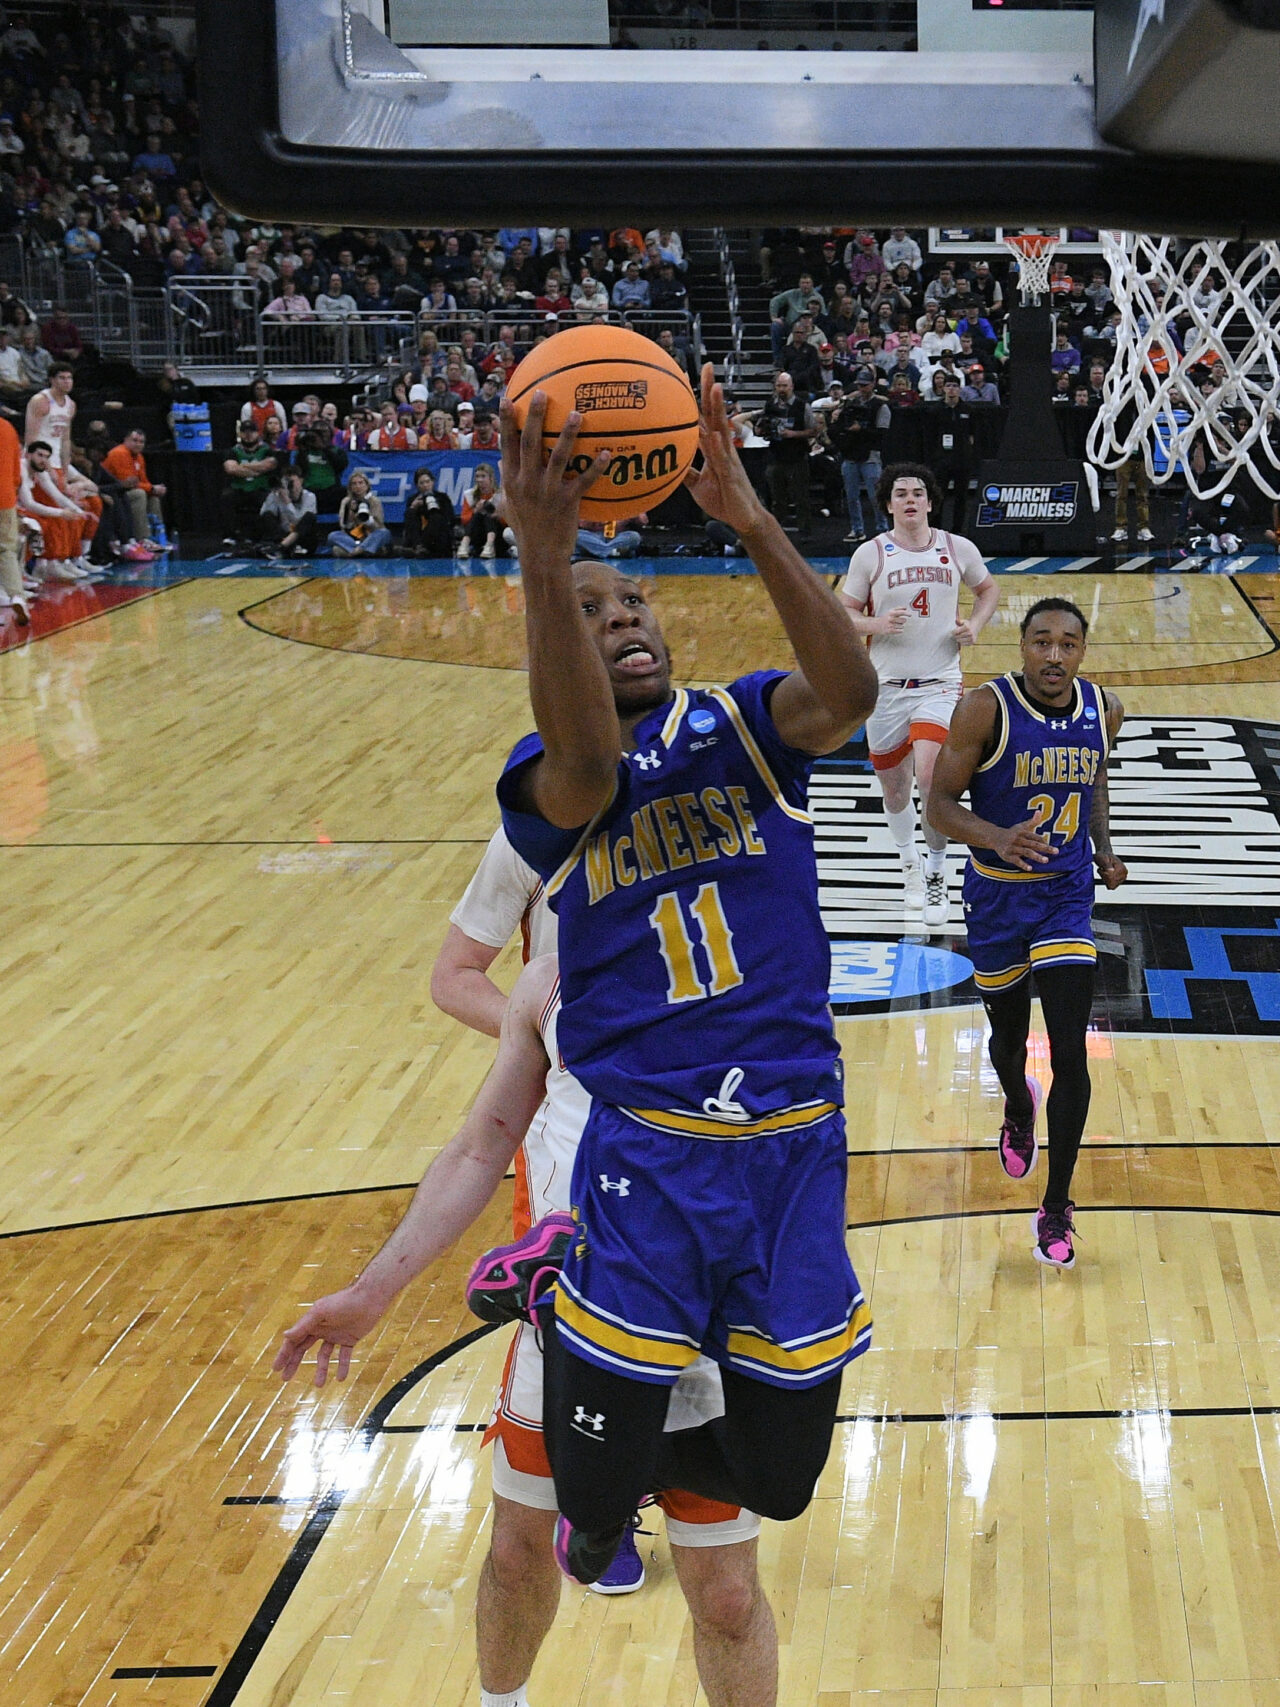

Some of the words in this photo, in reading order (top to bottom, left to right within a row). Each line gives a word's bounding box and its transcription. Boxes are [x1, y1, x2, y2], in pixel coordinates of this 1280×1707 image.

[576, 384, 630, 399] MADNESS
[594, 396, 634, 409] MARCH
[548, 444, 678, 486] Wilo
[1000, 487, 1051, 503] MARCH
[1005, 502, 1075, 519] MADNESS
[887, 566, 953, 590] CLEMSON
[909, 586, 931, 618] 4
[1012, 747, 1100, 789] McNEESE
[1026, 791, 1082, 847] 24
[584, 785, 768, 907] McNEESE
[647, 880, 745, 1005] 11
